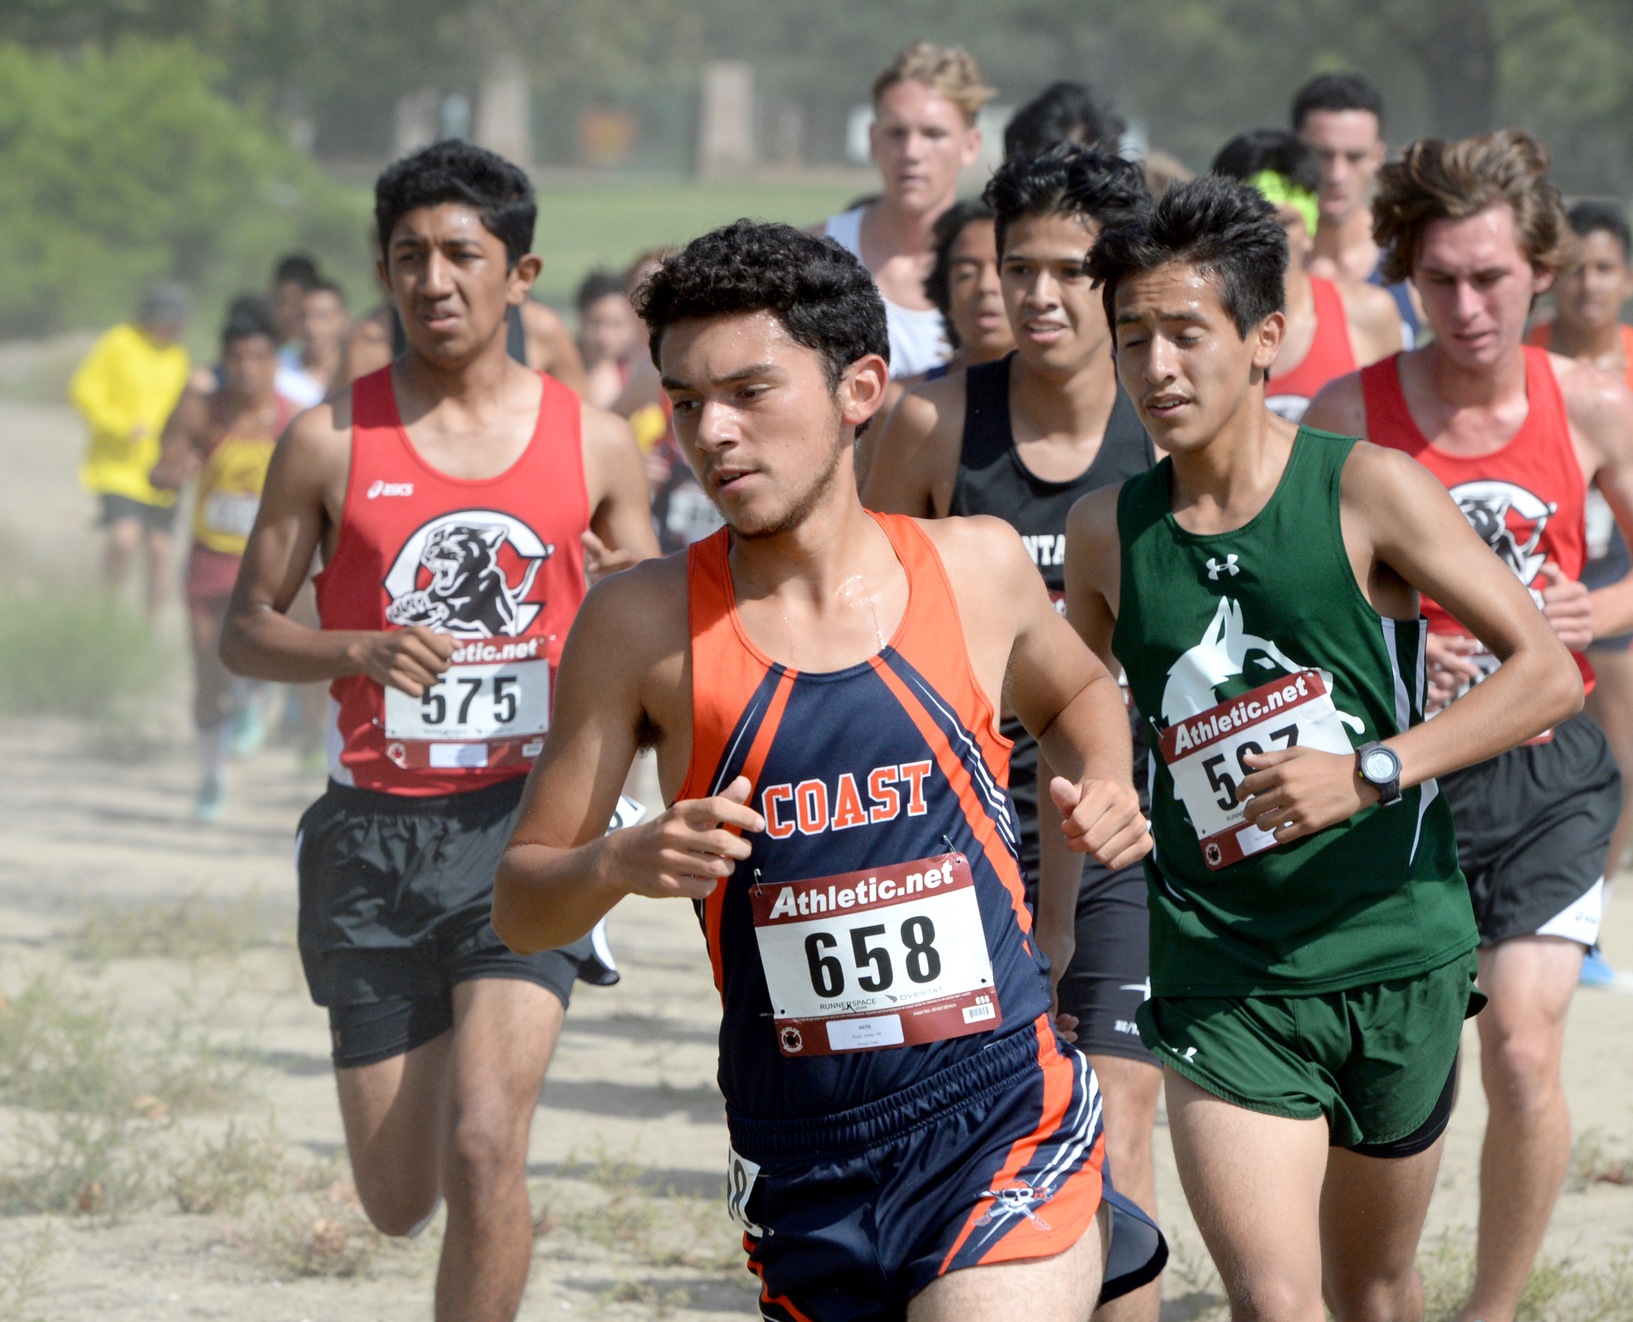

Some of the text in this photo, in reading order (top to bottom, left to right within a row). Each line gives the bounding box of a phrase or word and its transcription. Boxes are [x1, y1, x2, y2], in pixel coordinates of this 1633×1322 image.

[449, 638, 538, 662] etic.net
[421, 676, 518, 724] 575
[1174, 676, 1308, 756] Athletic.net
[762, 759, 932, 840] COAST
[769, 859, 954, 919] Athletic.net
[804, 915, 941, 998] 658
